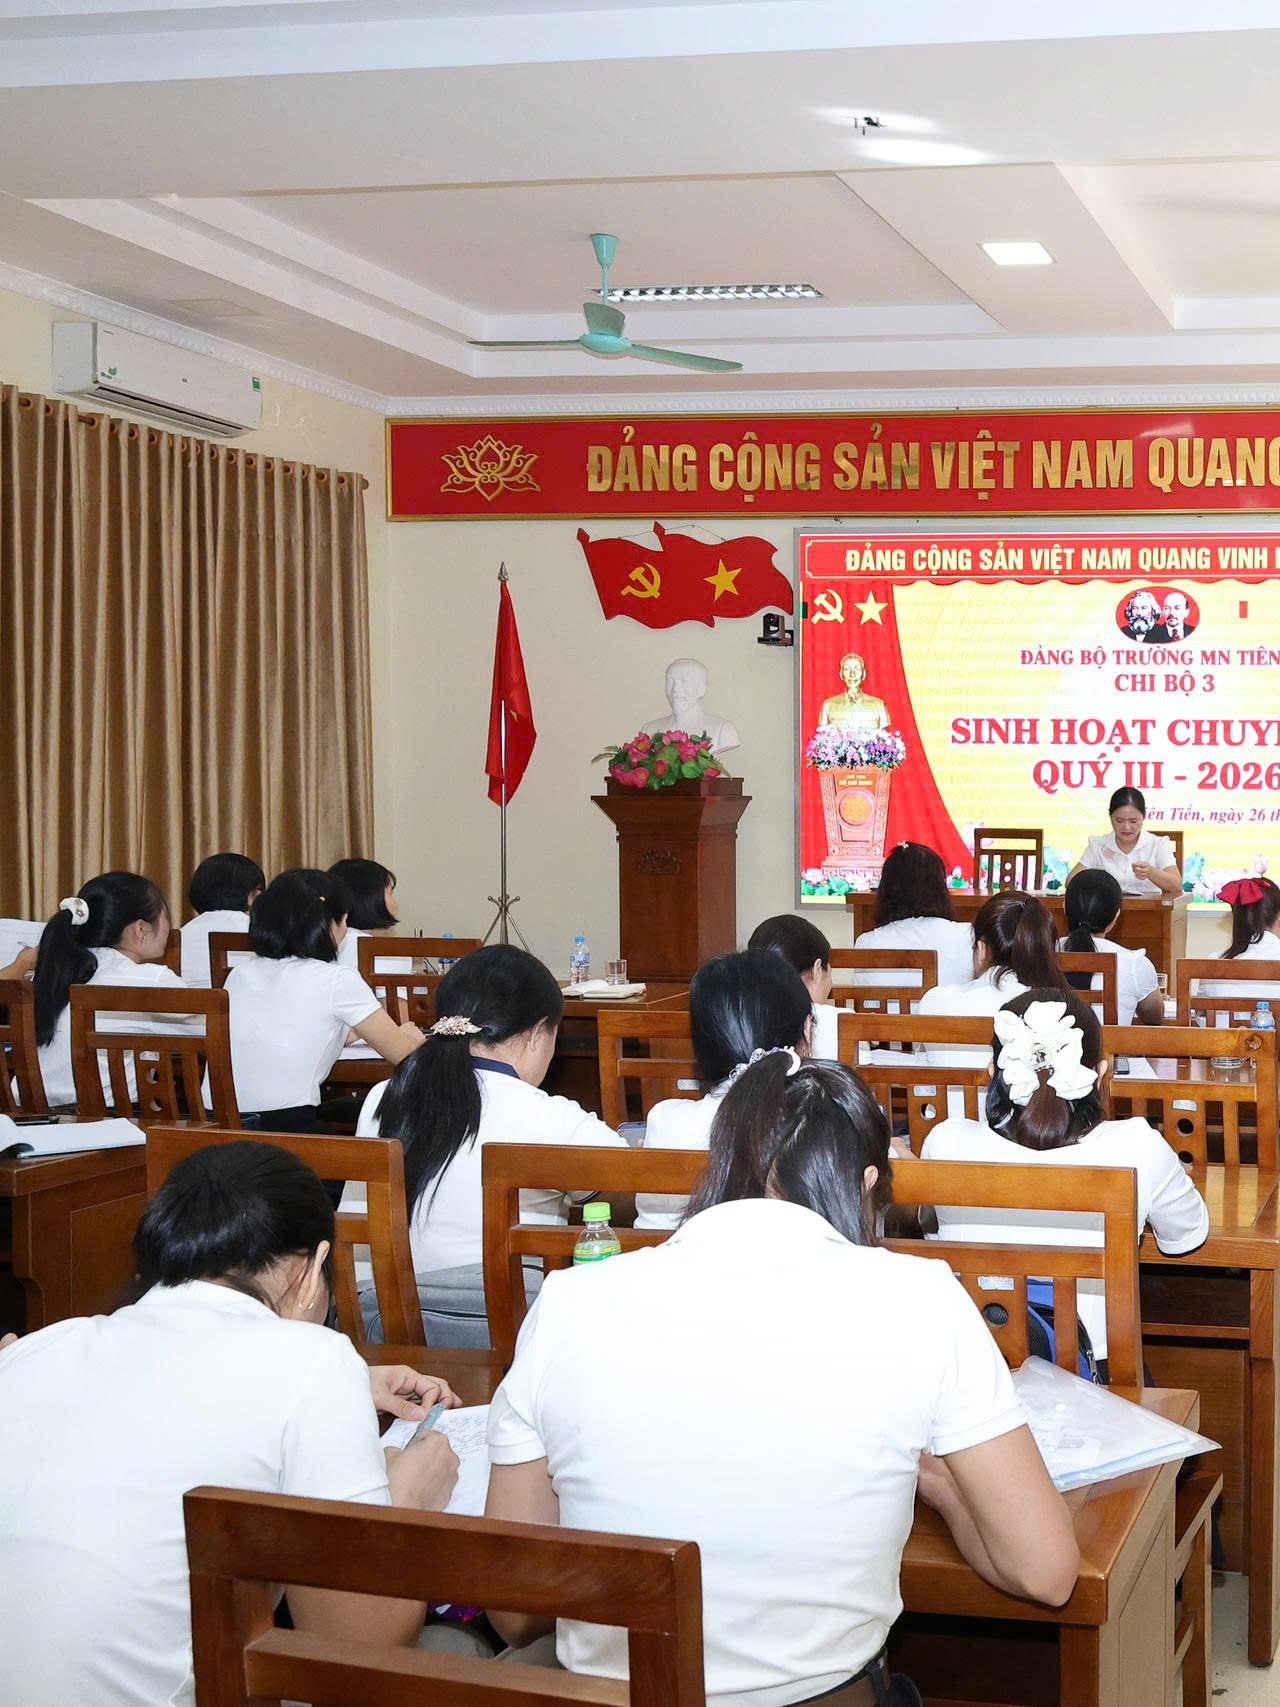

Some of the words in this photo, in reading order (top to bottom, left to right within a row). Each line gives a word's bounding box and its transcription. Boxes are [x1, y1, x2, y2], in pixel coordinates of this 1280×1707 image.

[587, 426, 696, 492] ĐẢNG
[709, 432, 820, 503] CỘNG
[833, 423, 919, 491] SẢN
[931, 430, 1020, 500] VIỆT
[1033, 440, 1133, 489] NAM
[845, 542, 906, 571] ĐẢNG
[913, 544, 972, 575] CỘNG
[979, 542, 1023, 570] SẢN
[1031, 544, 1075, 575] VIỆT
[1082, 548, 1131, 569] NAM
[1138, 547, 1211, 572] QUANG
[1218, 547, 1268, 569] VINH
[1020, 645, 1074, 665] ĐẢNG
[1080, 646, 1107, 669] BỘ
[1112, 646, 1194, 666] TRƯỜNG
[1200, 650, 1231, 665] MN
[1237, 646, 1280, 665] TIÊN
[1114, 674, 1156, 692] CHI
[1164, 670, 1195, 696] BỘ
[1202, 674, 1215, 692] 3
[951, 717, 1040, 744] SINH
[1050, 718, 1156, 753] HOẠT
[1033, 752, 1113, 794] QUÝ
[1122, 761, 1164, 788] III
[1143, 807, 1164, 820] iên
[1209, 808, 1244, 825] ngày
[1248, 808, 1266, 822] 26
